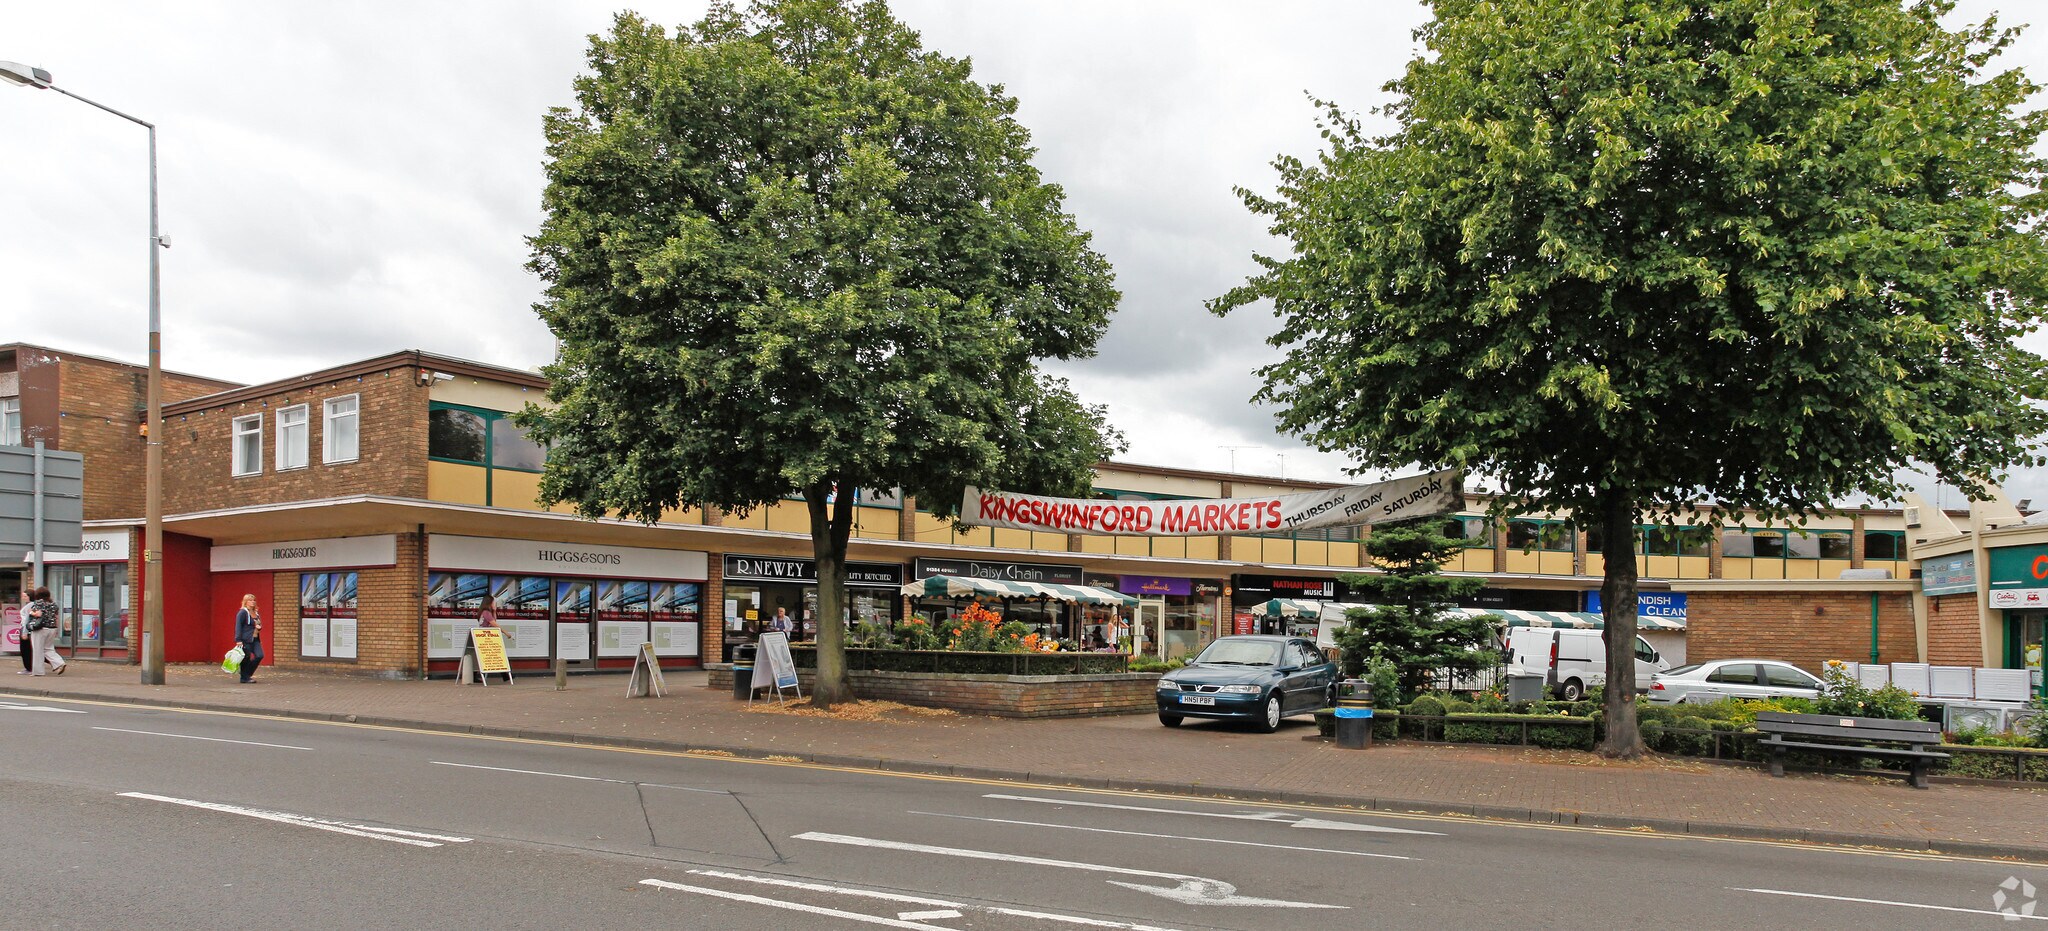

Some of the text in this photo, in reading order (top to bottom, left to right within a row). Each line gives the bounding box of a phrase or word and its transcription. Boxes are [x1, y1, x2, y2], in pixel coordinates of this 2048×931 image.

[979, 478, 1443, 533] KINGSWINFORD MARKETS THURSDAY FRIDAY SATURDAY
[970, 562, 1043, 580] Daisy Chain
[864, 573, 892, 581] BUTCHER
[1141, 583, 1171, 592] Hallmark
[1272, 580, 1323, 589] NATHAN ROSE
